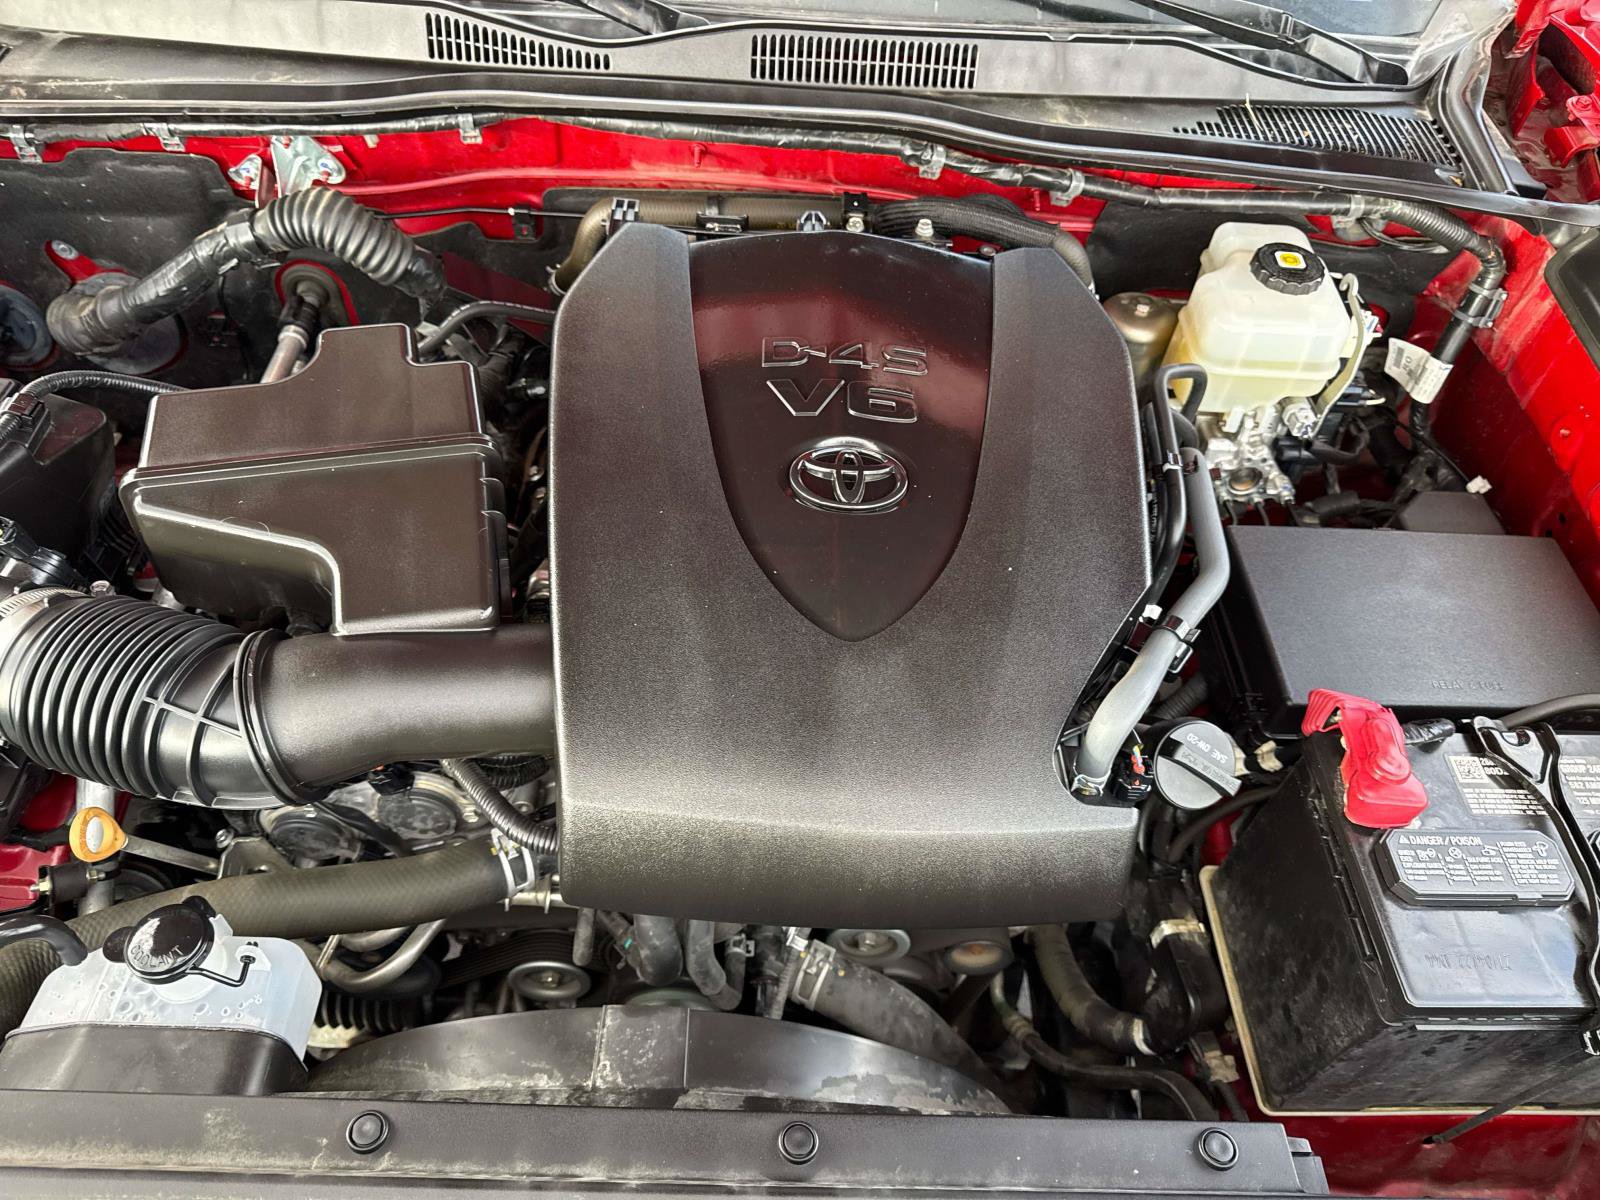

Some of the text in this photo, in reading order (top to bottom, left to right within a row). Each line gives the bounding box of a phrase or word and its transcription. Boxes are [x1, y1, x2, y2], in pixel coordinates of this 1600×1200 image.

[762, 337, 928, 376] D-4S
[766, 379, 918, 423] V6
[1432, 679, 1464, 690] RELAY
[1186, 732, 1229, 764] SAE 0W-20
[1409, 835, 1444, 846] DANGER
[1450, 835, 1483, 846] POISON
[130, 944, 184, 969] COOLANT
